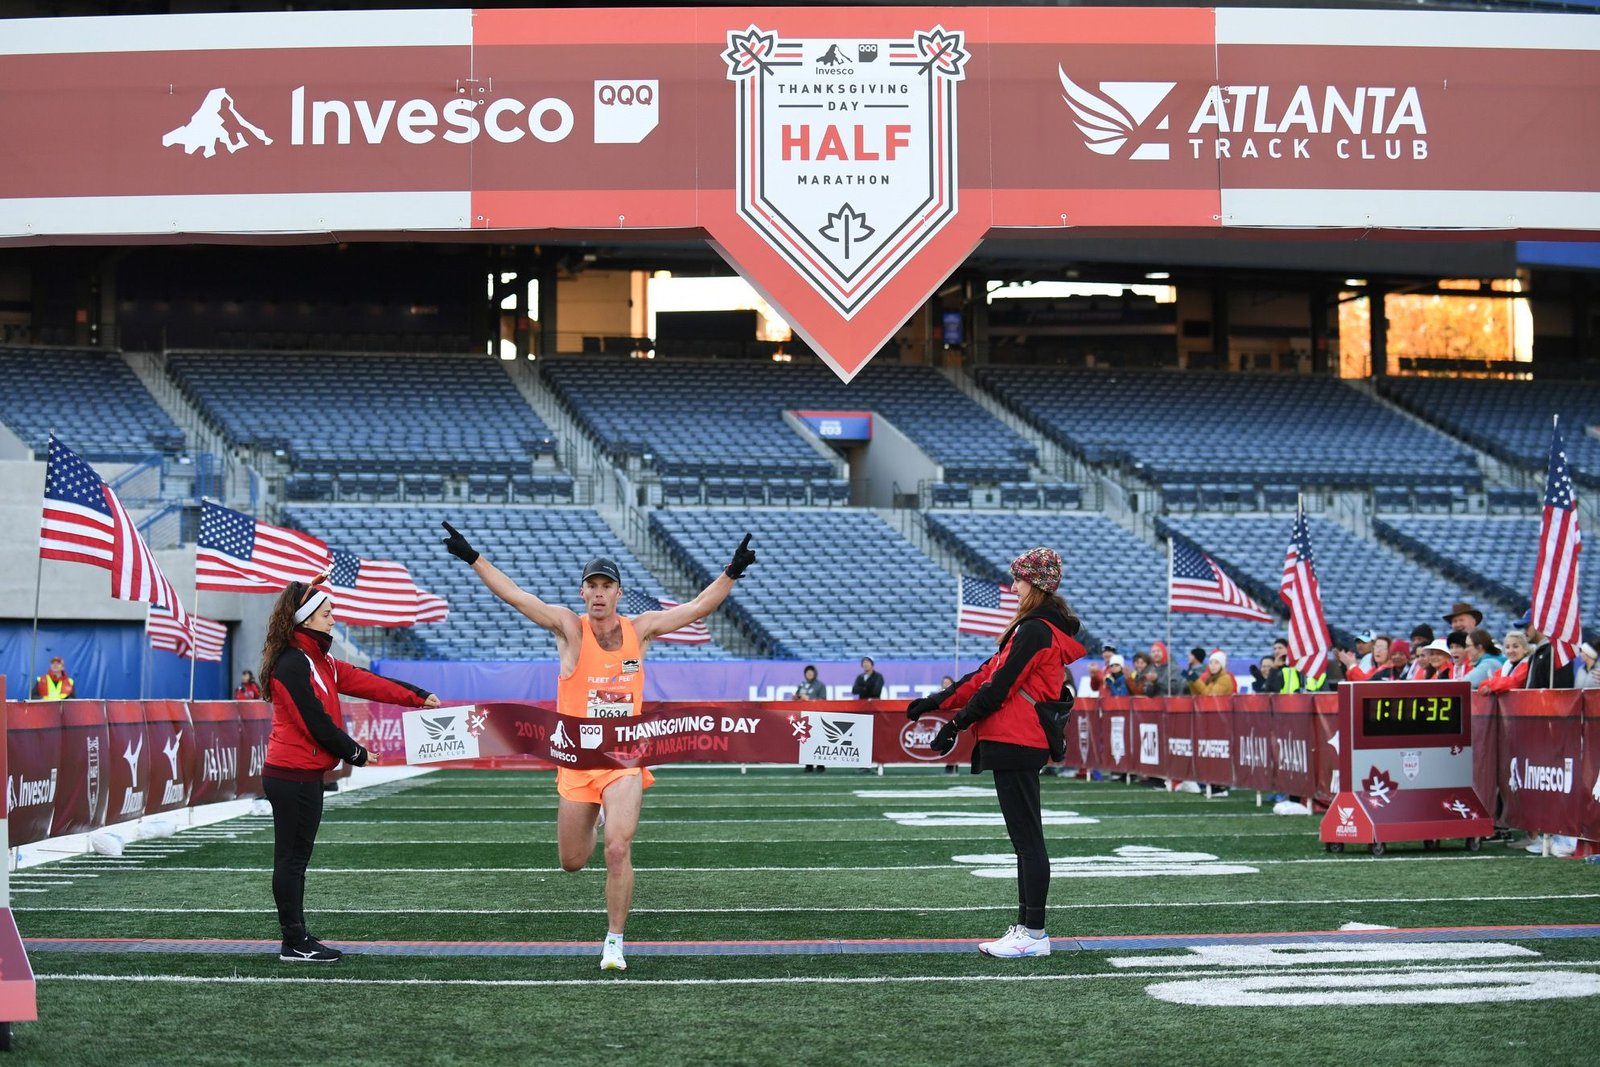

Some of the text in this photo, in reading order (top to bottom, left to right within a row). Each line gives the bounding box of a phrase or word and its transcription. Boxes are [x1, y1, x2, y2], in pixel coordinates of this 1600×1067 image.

[859, 44, 877, 52] QQQ
[816, 67, 854, 75] Invesco
[598, 84, 654, 107] QQQ
[778, 84, 909, 94] THANKSGIVING
[291, 85, 574, 145] Invesco
[828, 101, 859, 111] DAY
[1187, 85, 1427, 135] ATLANTA
[781, 124, 911, 161] HALF
[1189, 138, 1428, 160] TRACK CLUB
[797, 175, 890, 185] MARATHON
[593, 708, 628, 718] 10634
[514, 721, 546, 740] 2019
[580, 726, 601, 735] QQQ
[615, 715, 760, 742] THANKSGIVING DAY
[418, 740, 465, 754] ATLANTA
[549, 746, 577, 763] Invesco
[655, 735, 729, 757] MARATHON
[813, 745, 860, 758] ATLANTA
[1524, 758, 1564, 793] Invesco
[18, 774, 50, 807] Invesco
